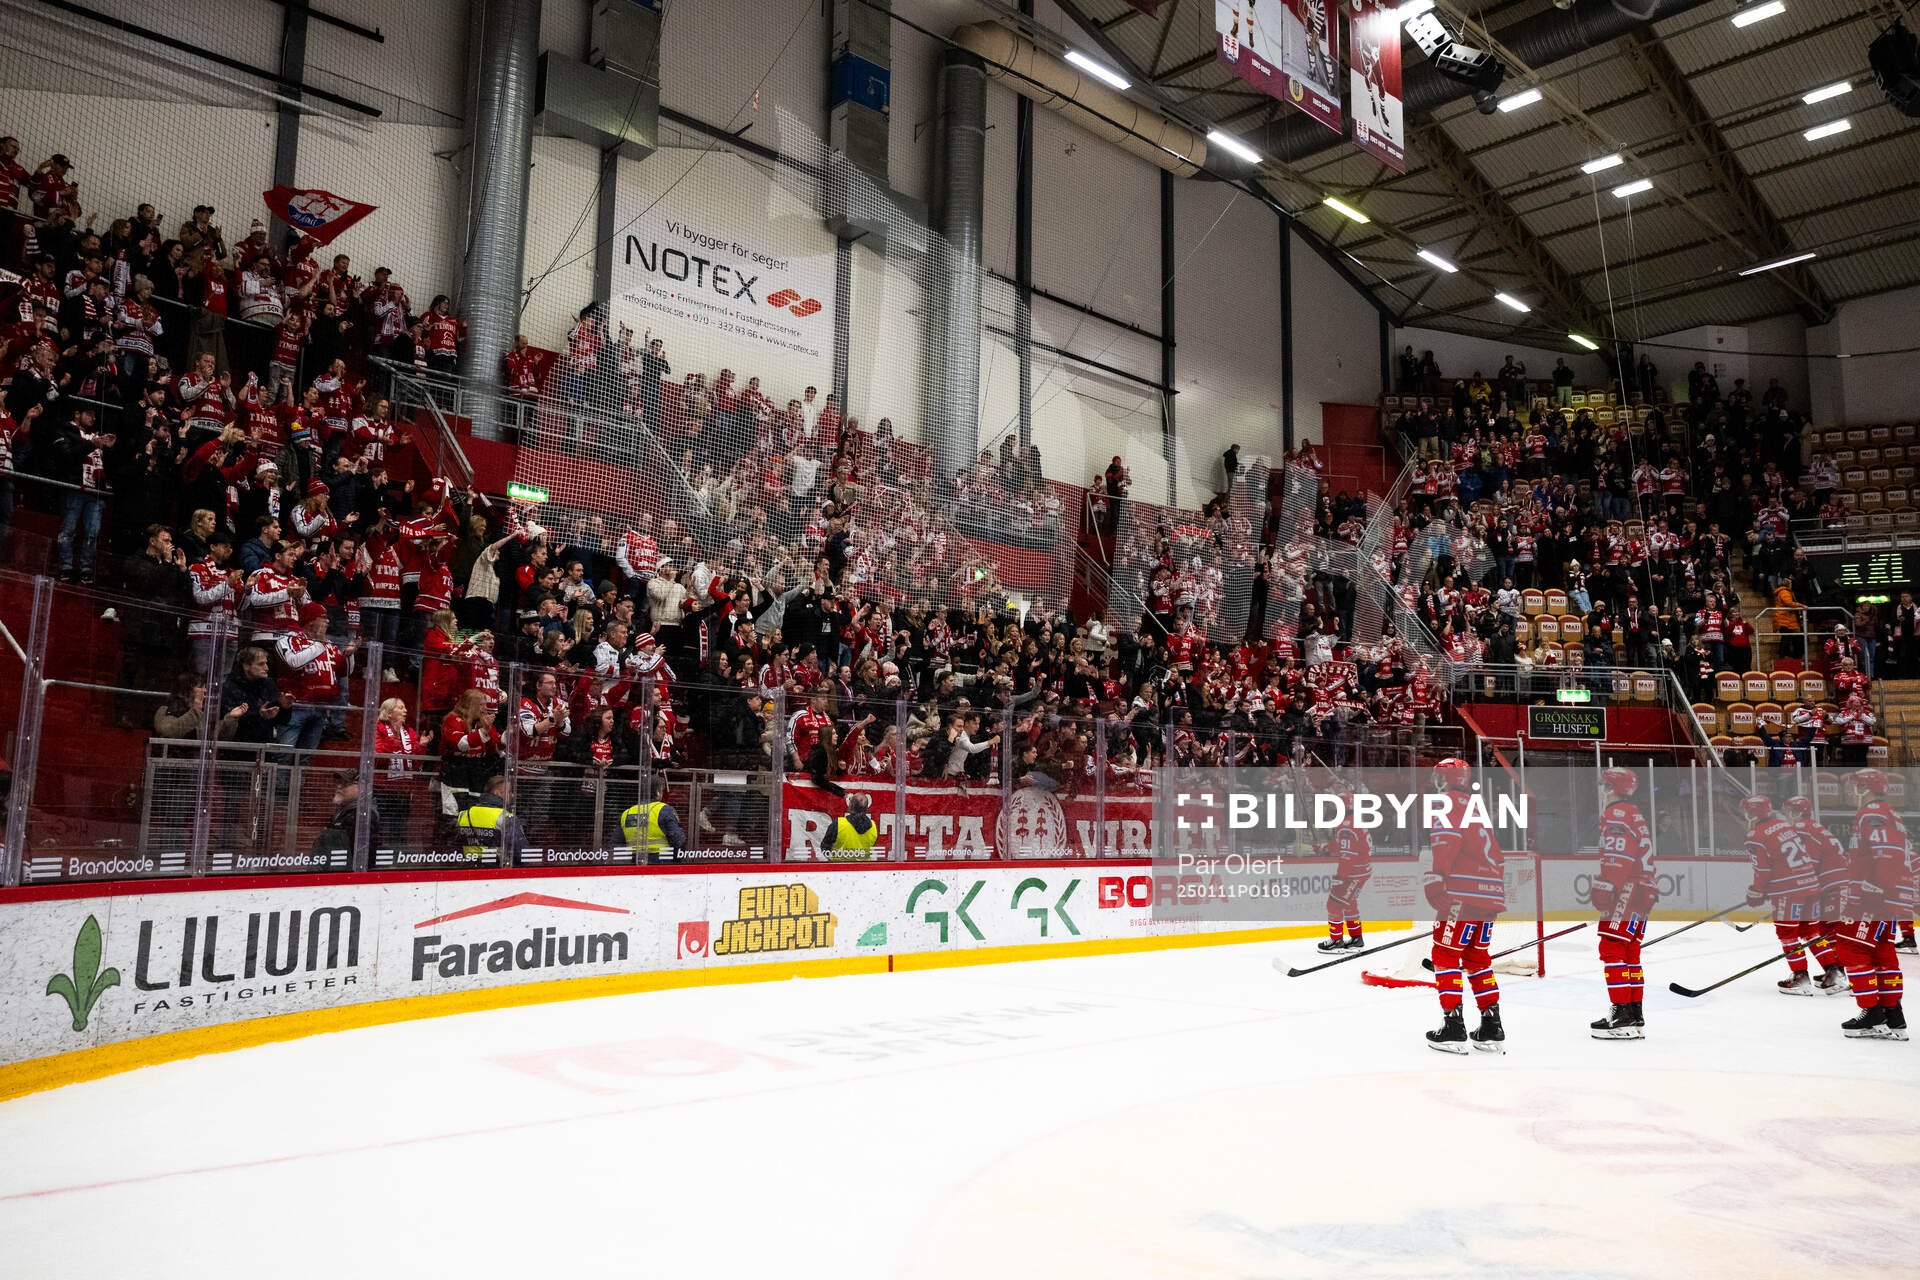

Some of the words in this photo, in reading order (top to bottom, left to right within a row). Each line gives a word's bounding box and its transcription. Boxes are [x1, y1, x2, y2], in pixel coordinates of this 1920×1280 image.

[666, 219, 680, 236] Vi
[683, 226, 728, 250] bygger
[732, 243, 749, 258] för
[752, 251, 789, 272] seger!
[625, 235, 758, 305] NOTEX
[766, 334, 819, 358] www.notex.se
[1542, 623, 1557, 631] MAXI
[1566, 623, 1580, 632] MAXI
[1721, 681, 1739, 689] MAXI
[1749, 681, 1766, 689] MAXI
[1776, 681, 1794, 689] MAXI
[1805, 681, 1822, 689] MAXI
[1535, 711, 1598, 724] GRÖNSAKS
[1698, 714, 1715, 722] MAXI
[1735, 714, 1752, 722] MAXI
[1763, 714, 1781, 722] MAXI
[1552, 724, 1590, 734] HUSET
[1819, 785, 1838, 793] MAXI
[785, 793, 990, 861] RTTA
[1869, 829, 1888, 843] 41
[1604, 836, 1626, 851] 28
[236, 853, 327, 868] brandcode.se
[397, 850, 478, 864] brandcode.se
[547, 848, 609, 862] Brandcode
[677, 847, 747, 860] brandcode.se
[69, 856, 154, 876] Brandcode
[1098, 874, 1230, 909] BORGA
[739, 884, 808, 919] EURO
[1010, 877, 1081, 937] GK
[905, 879, 986, 943] GK
[1130, 918, 1147, 927] BYGG
[714, 914, 830, 955] JACKPOT
[135, 905, 361, 992] LILIUM
[411, 927, 628, 981] Faradium
[134, 975, 357, 1015] FASTIGHETER
